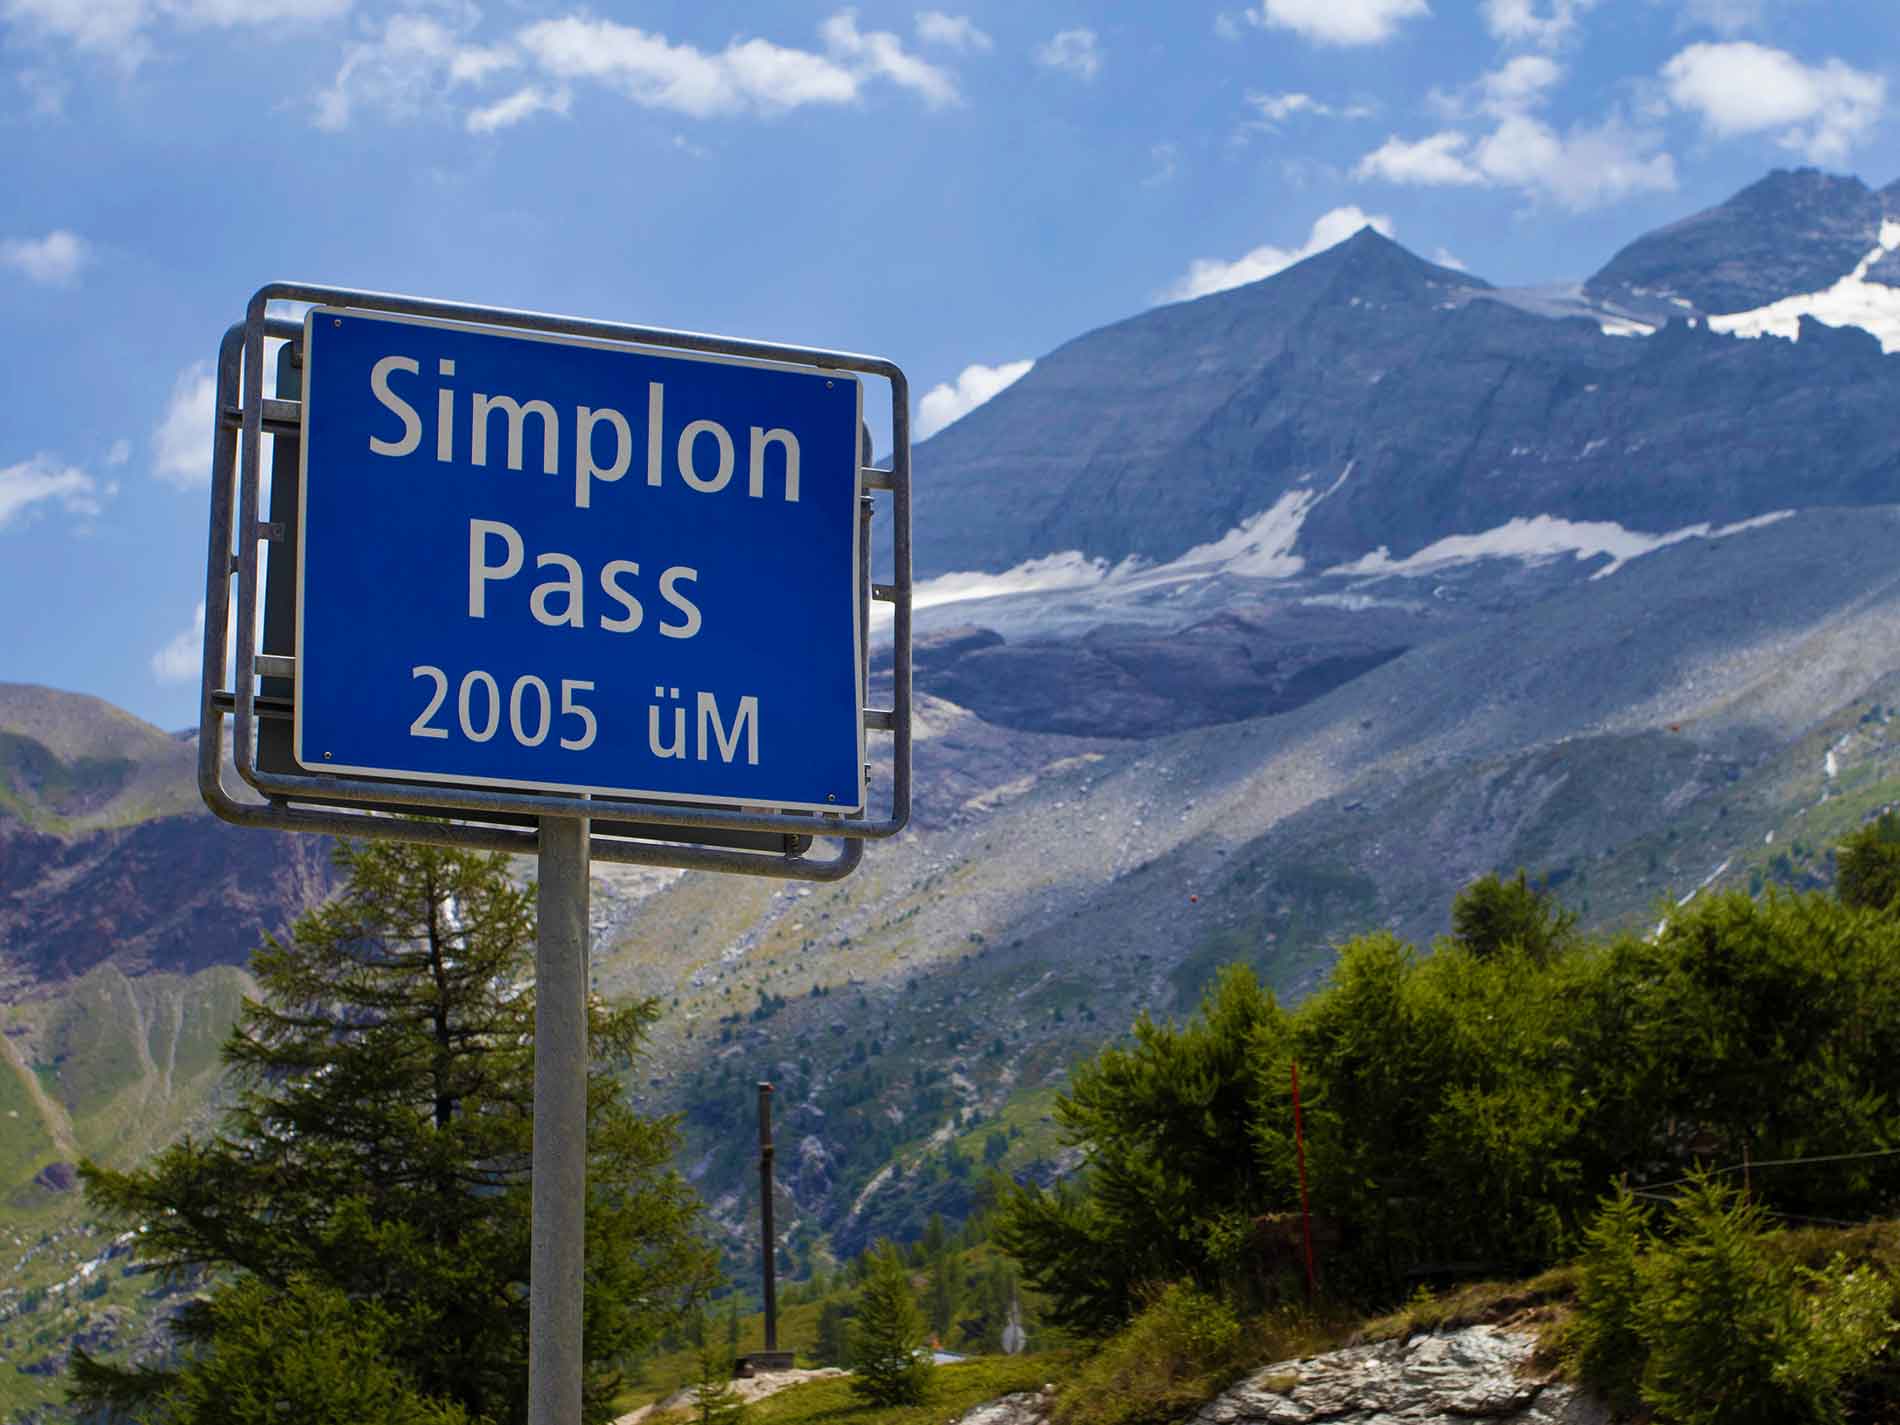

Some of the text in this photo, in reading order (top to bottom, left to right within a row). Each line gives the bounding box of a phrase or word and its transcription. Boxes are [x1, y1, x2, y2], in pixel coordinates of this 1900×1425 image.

[369, 356, 801, 508] Simplon
[468, 518, 703, 639] Pass
[409, 665, 760, 766] 2005 üM
